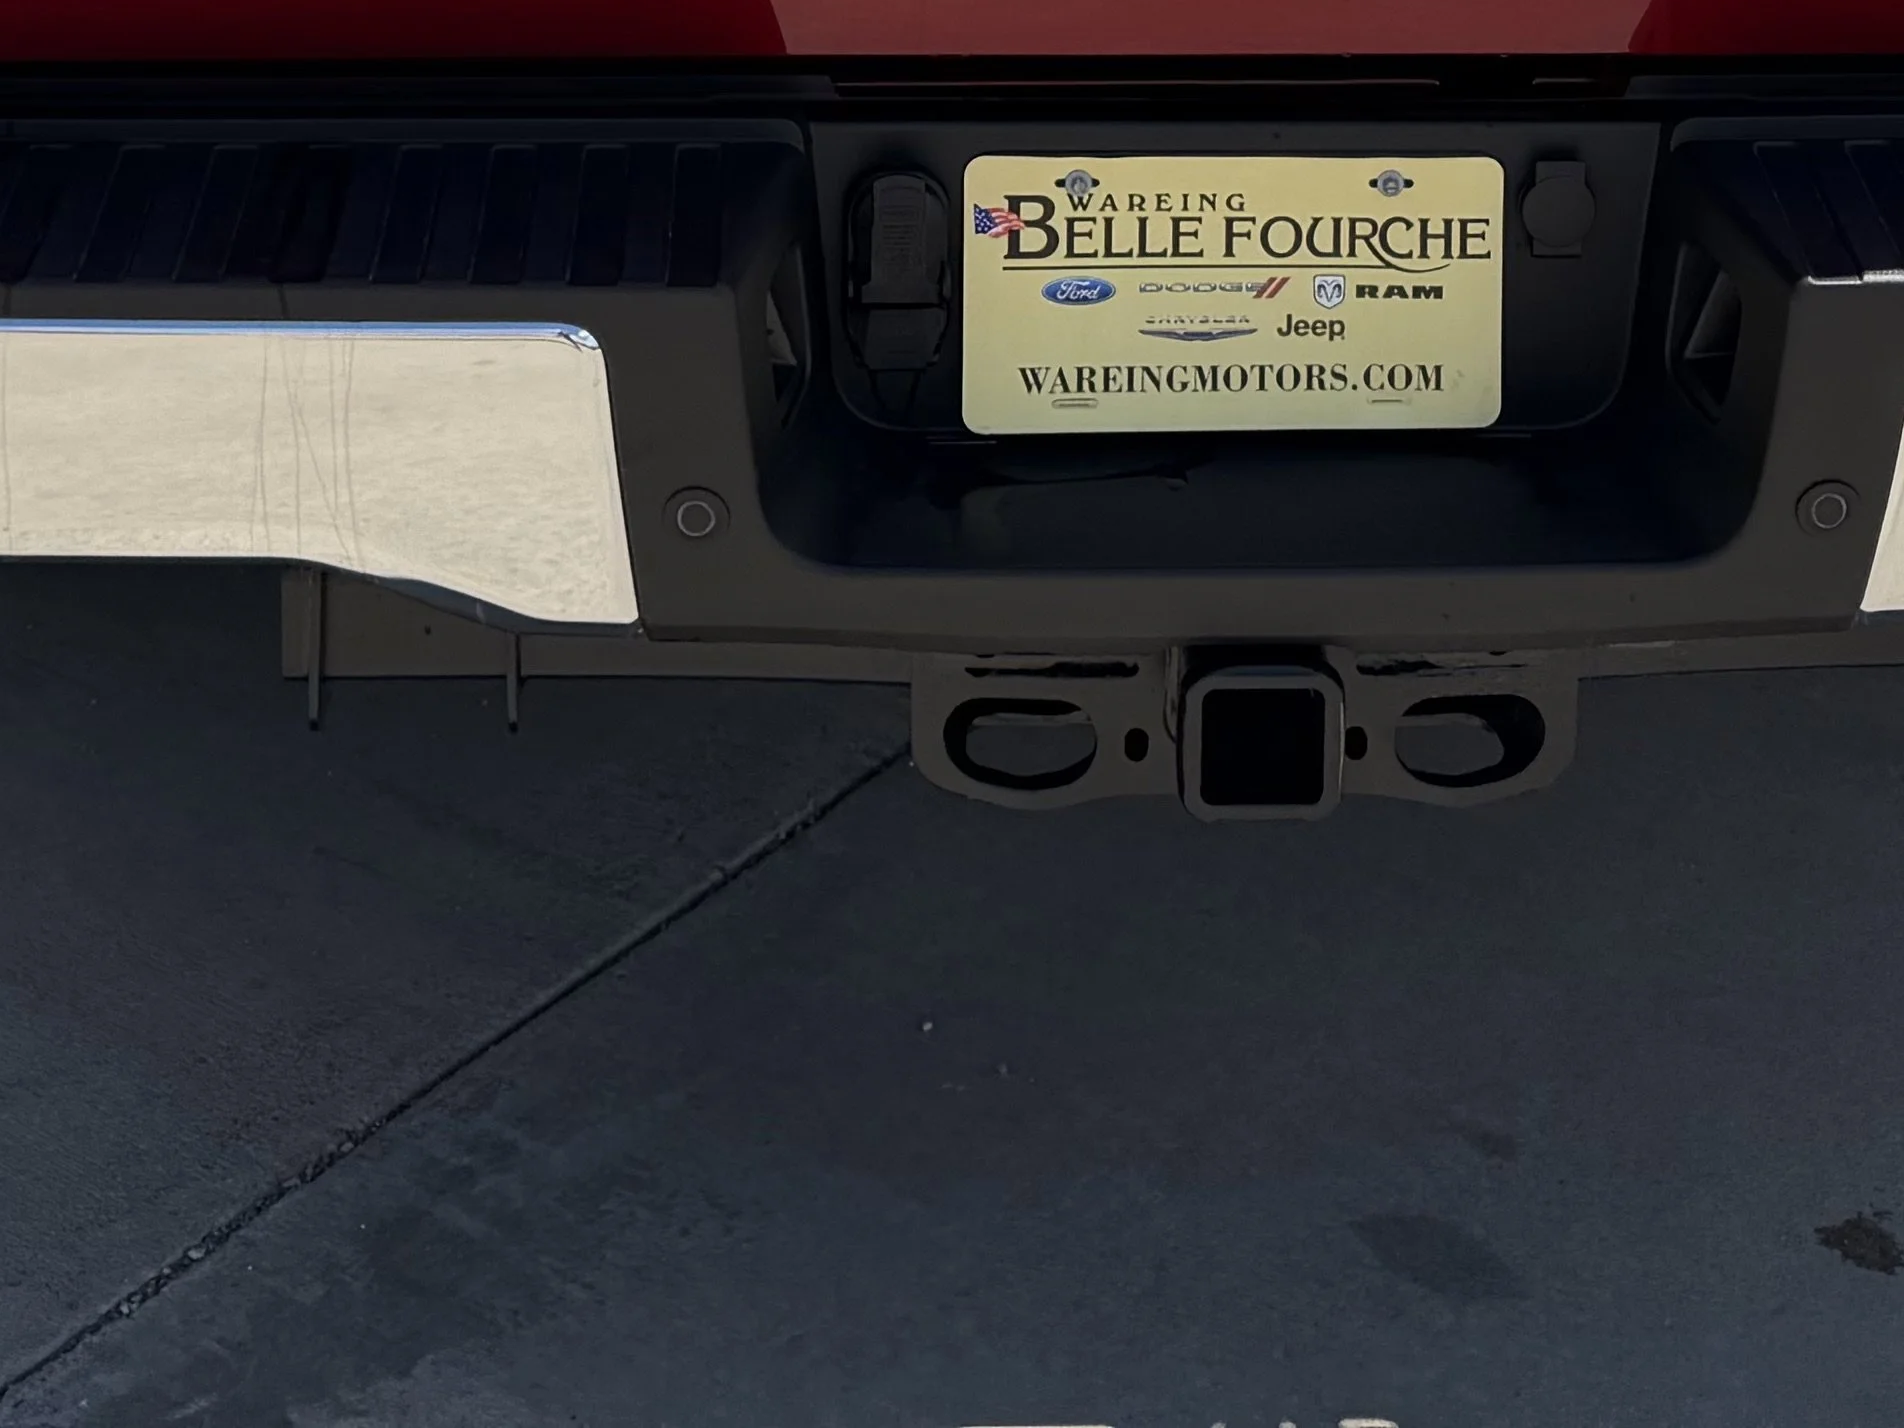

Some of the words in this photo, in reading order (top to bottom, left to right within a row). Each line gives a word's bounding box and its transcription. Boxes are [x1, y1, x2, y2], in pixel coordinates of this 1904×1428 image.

[1066, 192, 1247, 213] WAREING
[1002, 194, 1204, 261] BELLE
[1222, 215, 1492, 273] FOURCHE
[1055, 279, 1101, 300] Ford
[1139, 282, 1266, 293] DODGE
[1355, 284, 1444, 300] RAM
[1276, 314, 1346, 341] Jeep
[1018, 363, 1445, 396] WAREINGMOTORS.COM
